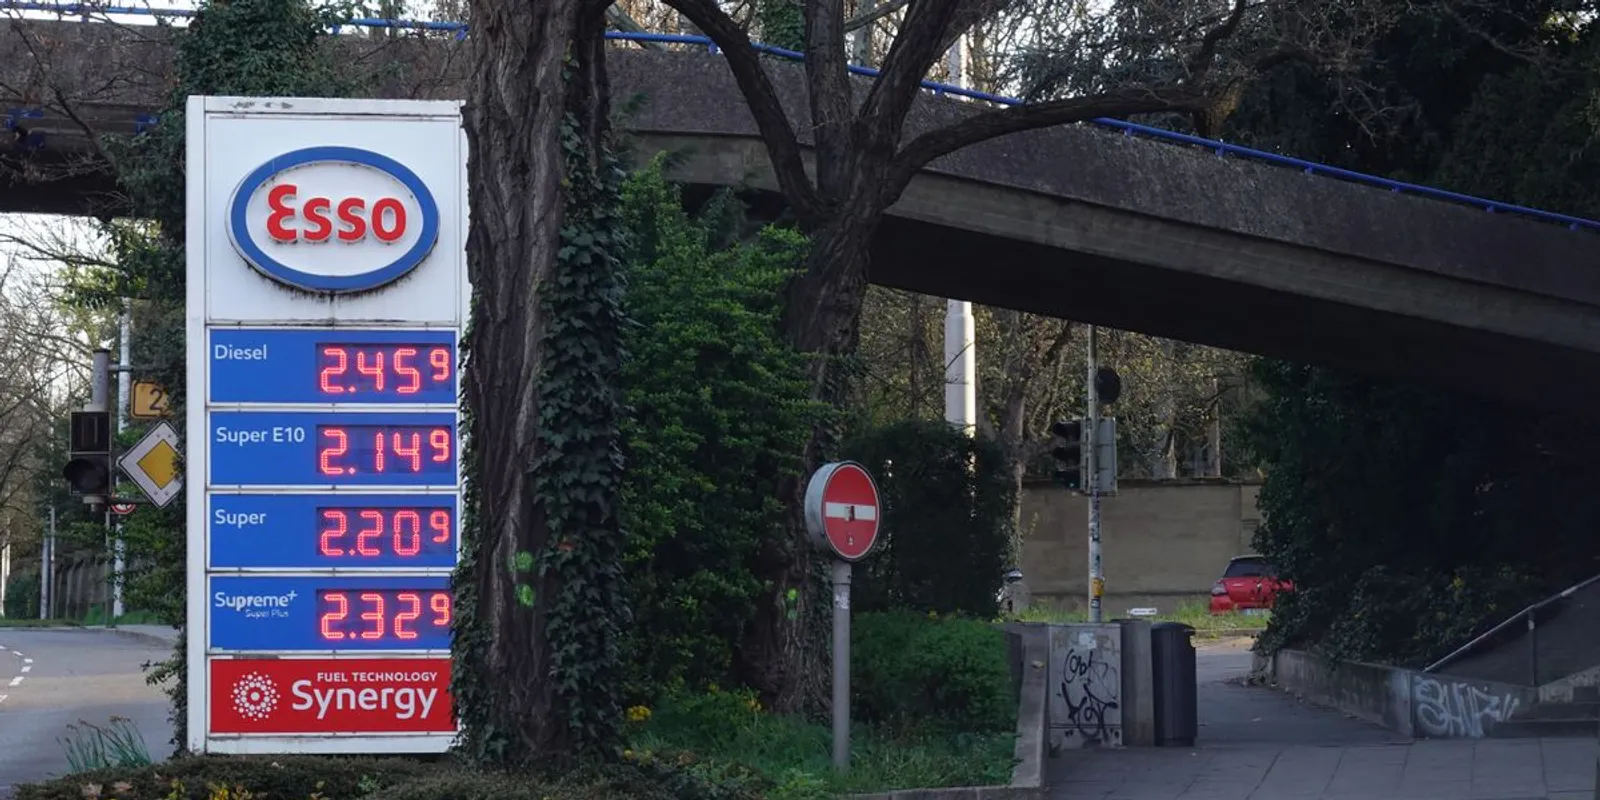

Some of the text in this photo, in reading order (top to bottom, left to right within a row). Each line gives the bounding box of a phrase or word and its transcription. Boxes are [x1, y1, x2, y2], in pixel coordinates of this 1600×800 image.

[266, 184, 407, 242] Esso
[214, 344, 268, 360] Diesel
[320, 348, 449, 394] 2.459
[216, 427, 305, 446] Super E10
[320, 429, 449, 475] 2.149
[214, 509, 266, 529] Super
[320, 510, 449, 556] 2.209
[245, 609, 289, 619] Super Plus
[320, 593, 450, 640] 2.329
[317, 672, 438, 683] FUEL TECHNOLOGY
[291, 679, 438, 720] Synergy
